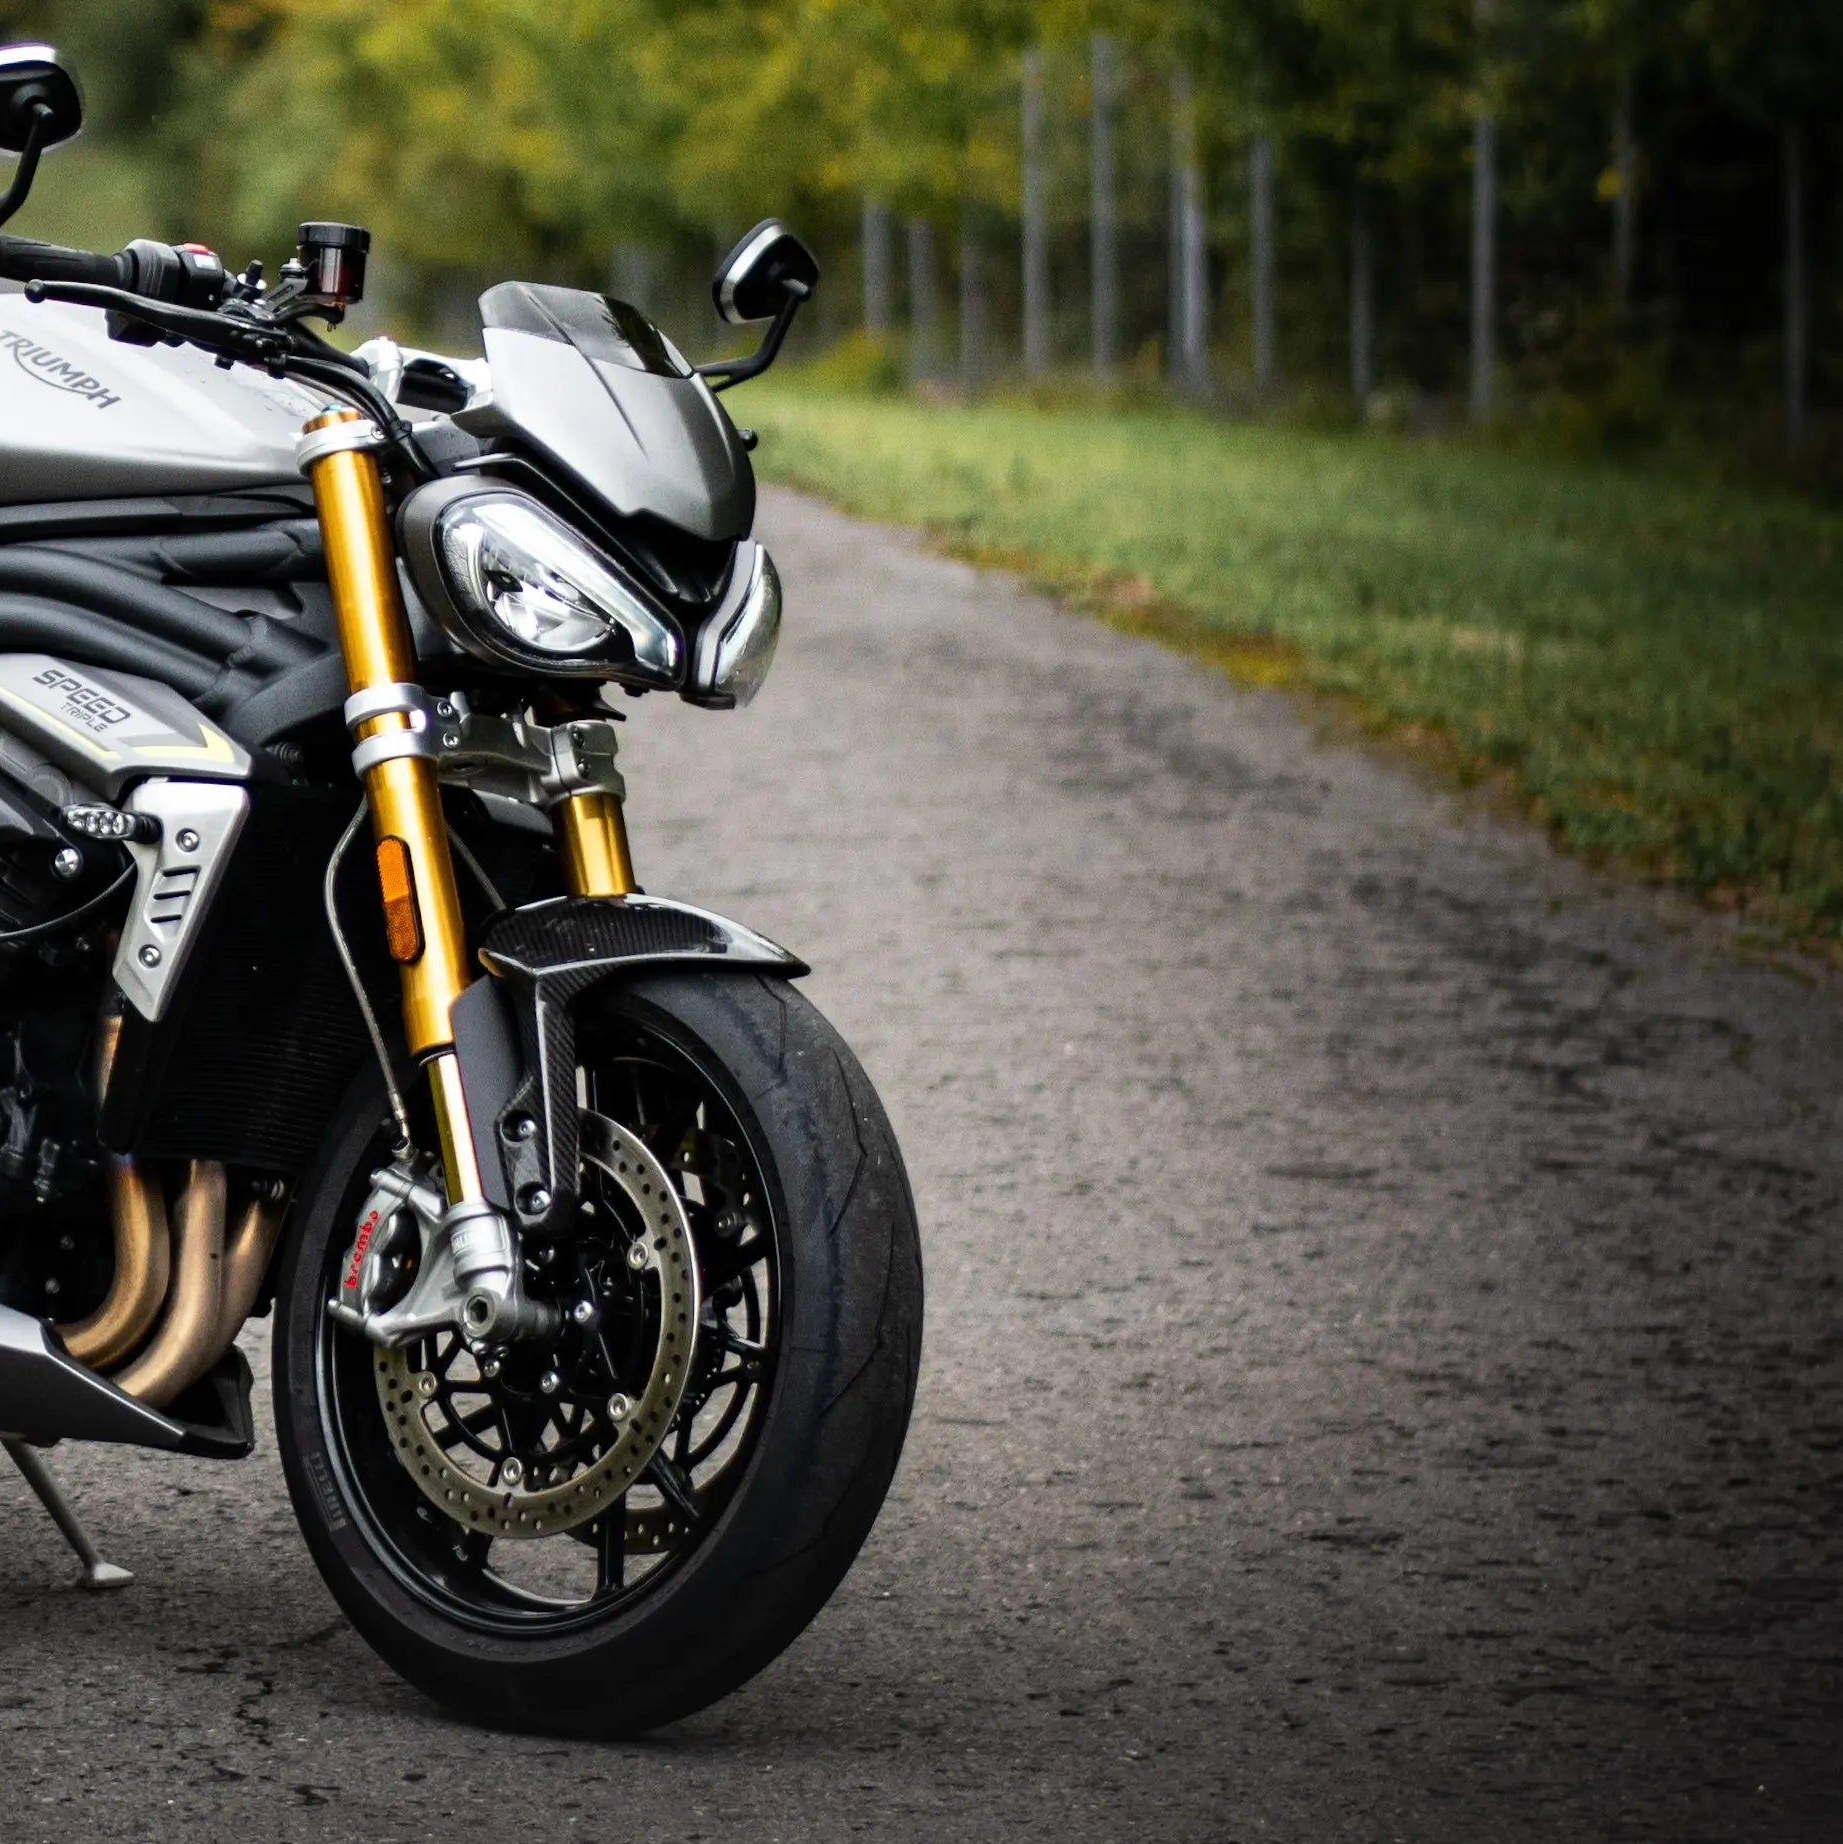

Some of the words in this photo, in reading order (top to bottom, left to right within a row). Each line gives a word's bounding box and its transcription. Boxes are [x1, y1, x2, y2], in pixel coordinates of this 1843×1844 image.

[32, 669, 131, 724] SPEED
[60, 702, 108, 732] TRIPLE
[343, 1210, 379, 1288] brembo
